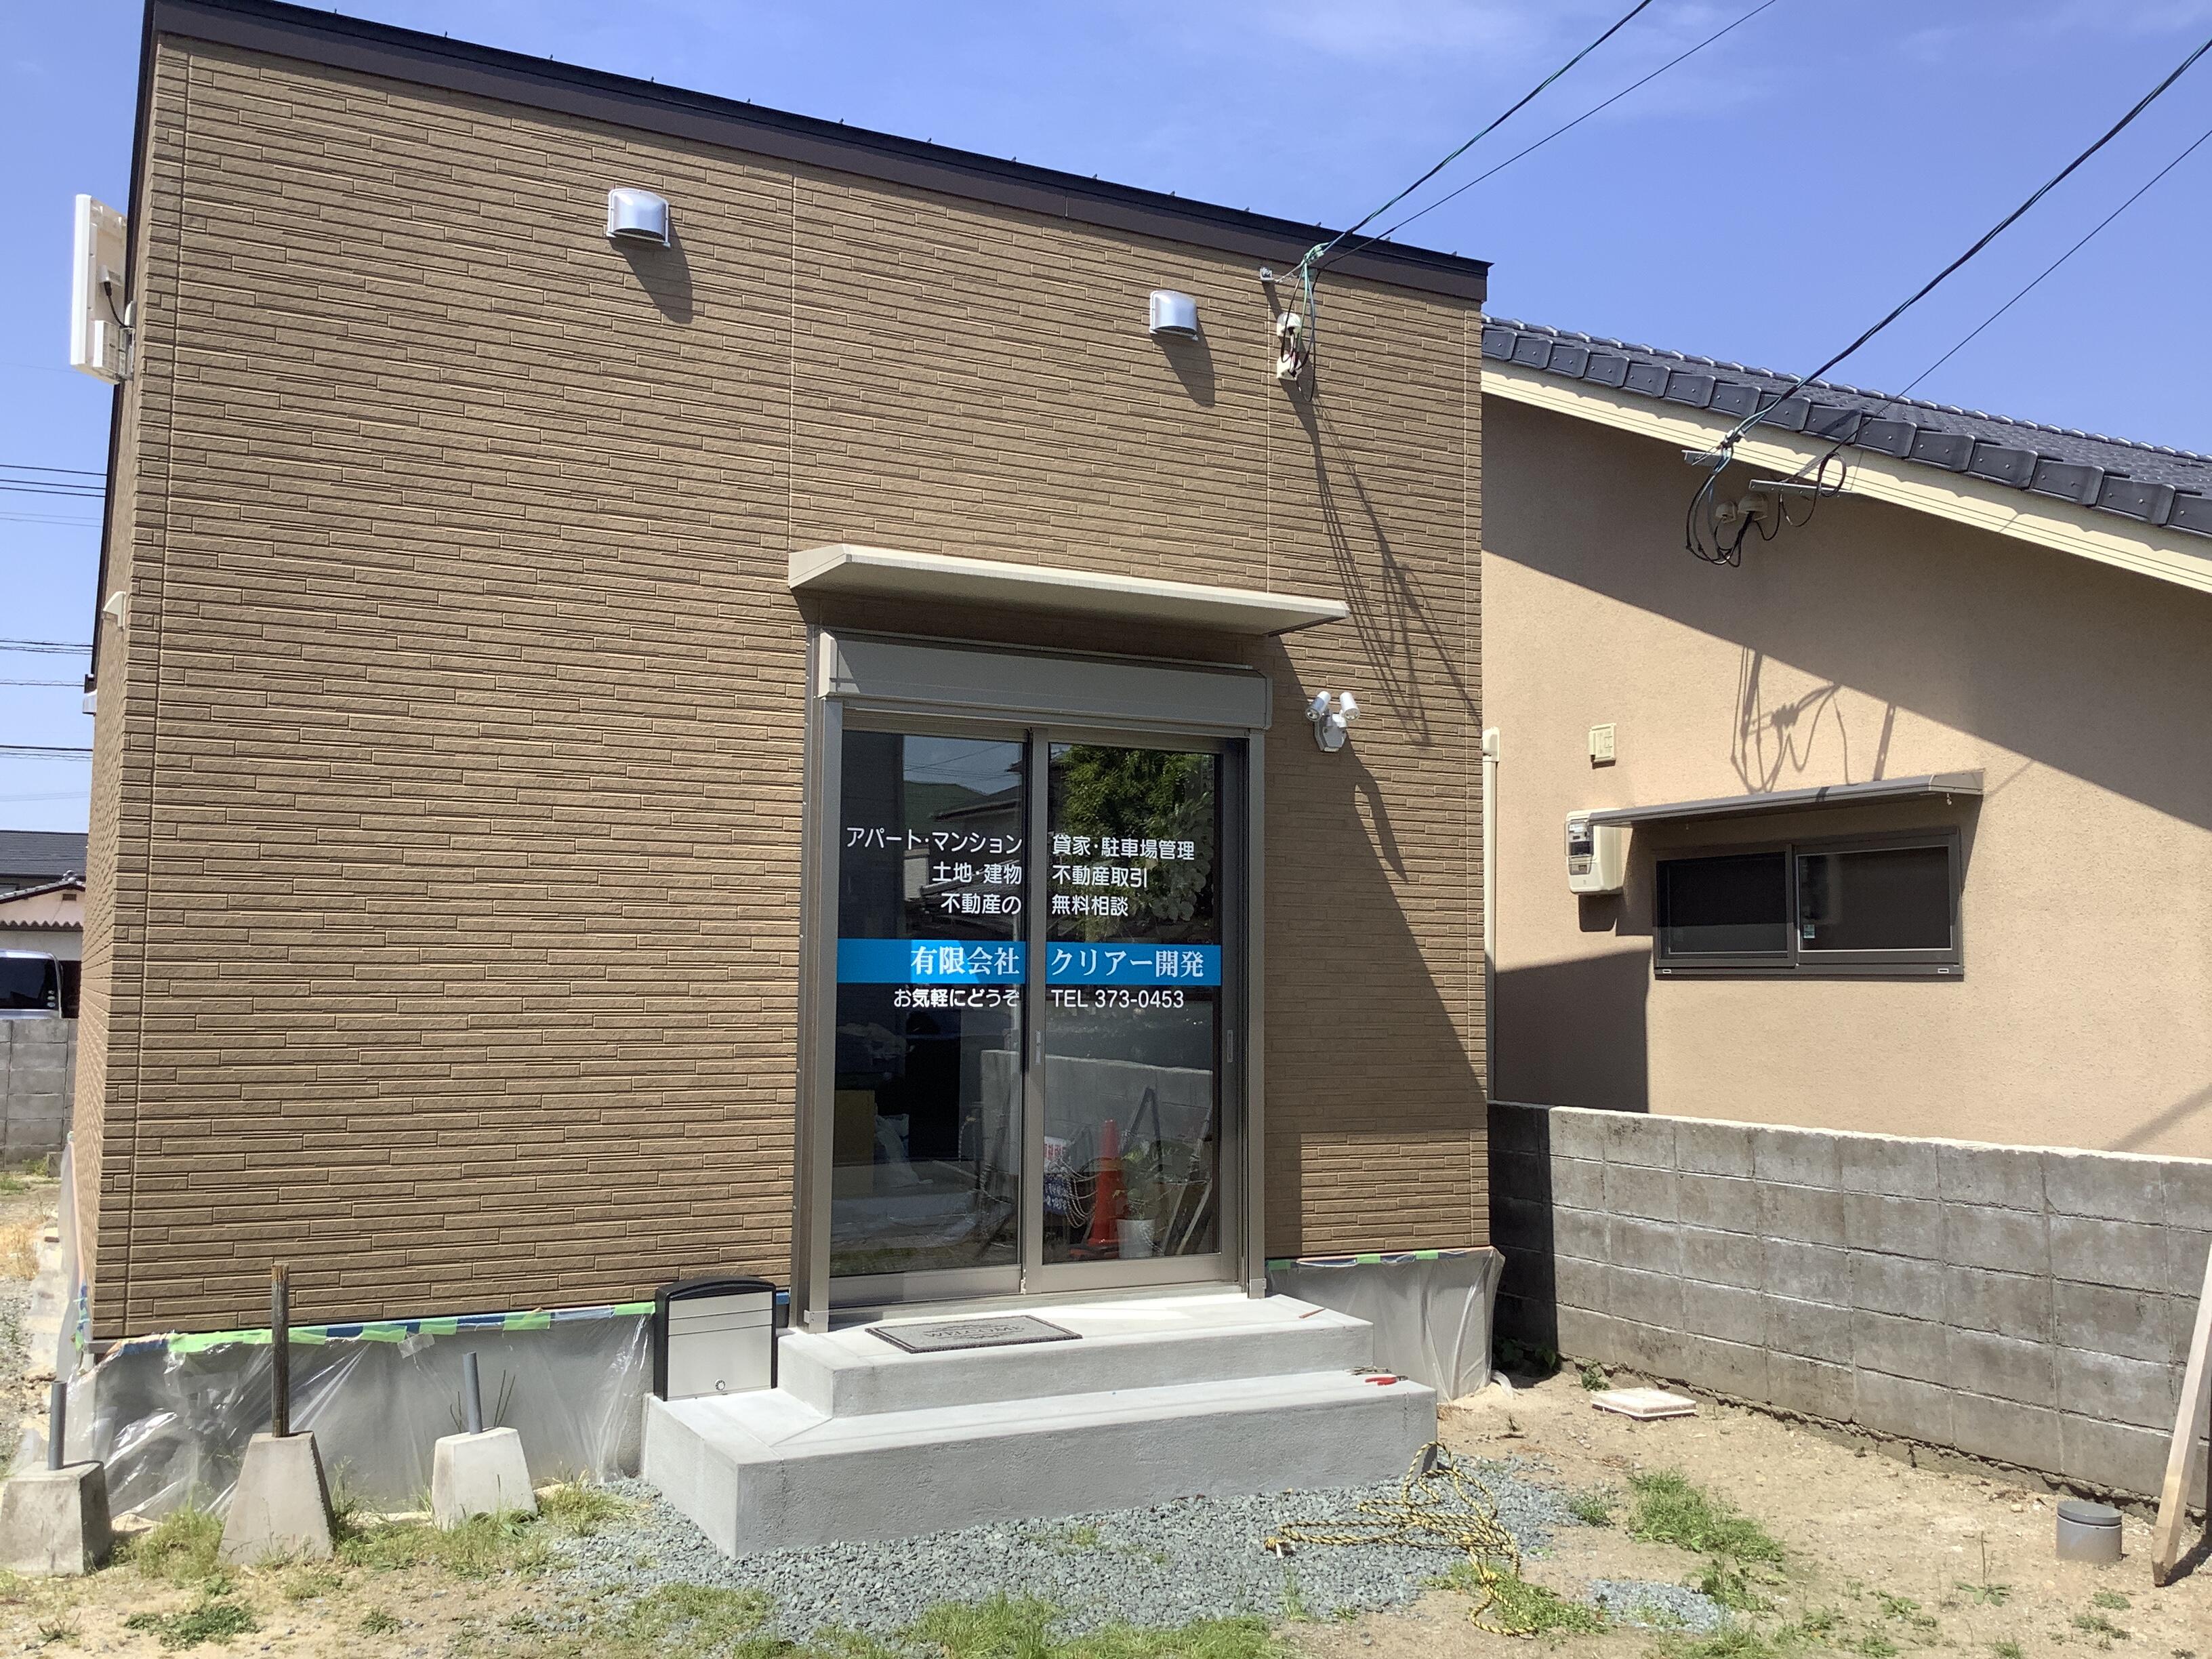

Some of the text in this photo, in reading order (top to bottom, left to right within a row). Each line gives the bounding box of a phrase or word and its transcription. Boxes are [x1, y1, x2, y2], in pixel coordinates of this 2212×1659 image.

[847, 827, 1195, 861] アパート・マンション 貸家・駐車場管理
[932, 861, 1147, 888] 土地・建物 不動産取引
[941, 893, 1128, 917] 不動産の 無料相談
[910, 945, 1204, 978] 有限会社 クリアー開発
[894, 988, 1184, 1008] お気軽にどうぞ TEL 373-0453
[923, 1325, 1025, 1338] WELCOME
